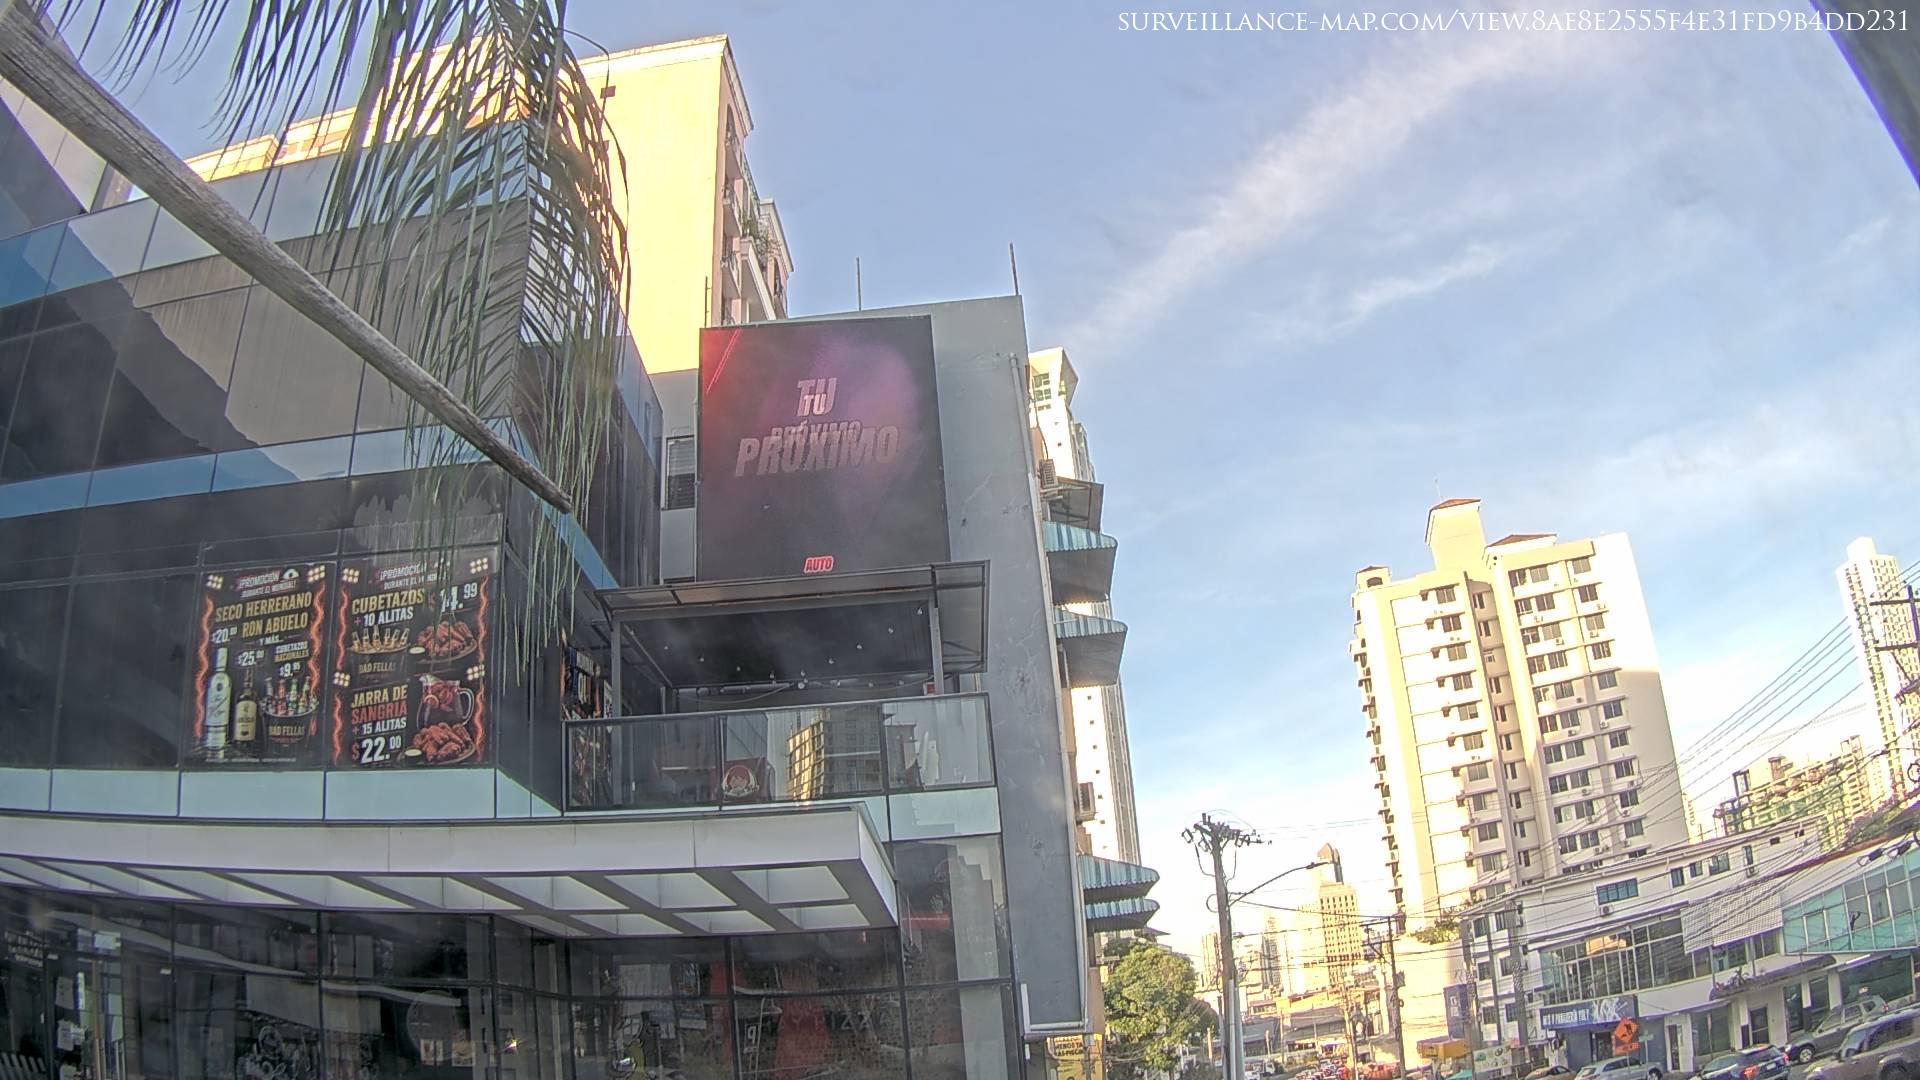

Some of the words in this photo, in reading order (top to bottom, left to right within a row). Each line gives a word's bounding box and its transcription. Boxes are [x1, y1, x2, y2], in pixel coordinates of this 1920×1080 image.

[796, 377, 838, 417] TU
[806, 558, 832, 572] AUTO
[215, 601, 242, 622] SECO
[246, 591, 312, 617] HERRERANO
[351, 588, 425, 615] CUBETAZOS
[242, 621, 263, 638] RON
[265, 612, 309, 634] ABUELO
[364, 613, 375, 627] 10
[378, 607, 414, 625] ALITAS
[351, 689, 391, 708] JARRA
[393, 685, 408, 700] DE
[361, 724, 373, 736] 15
[375, 716, 408, 734] ALITAS
[351, 735, 402, 764] $22.00
